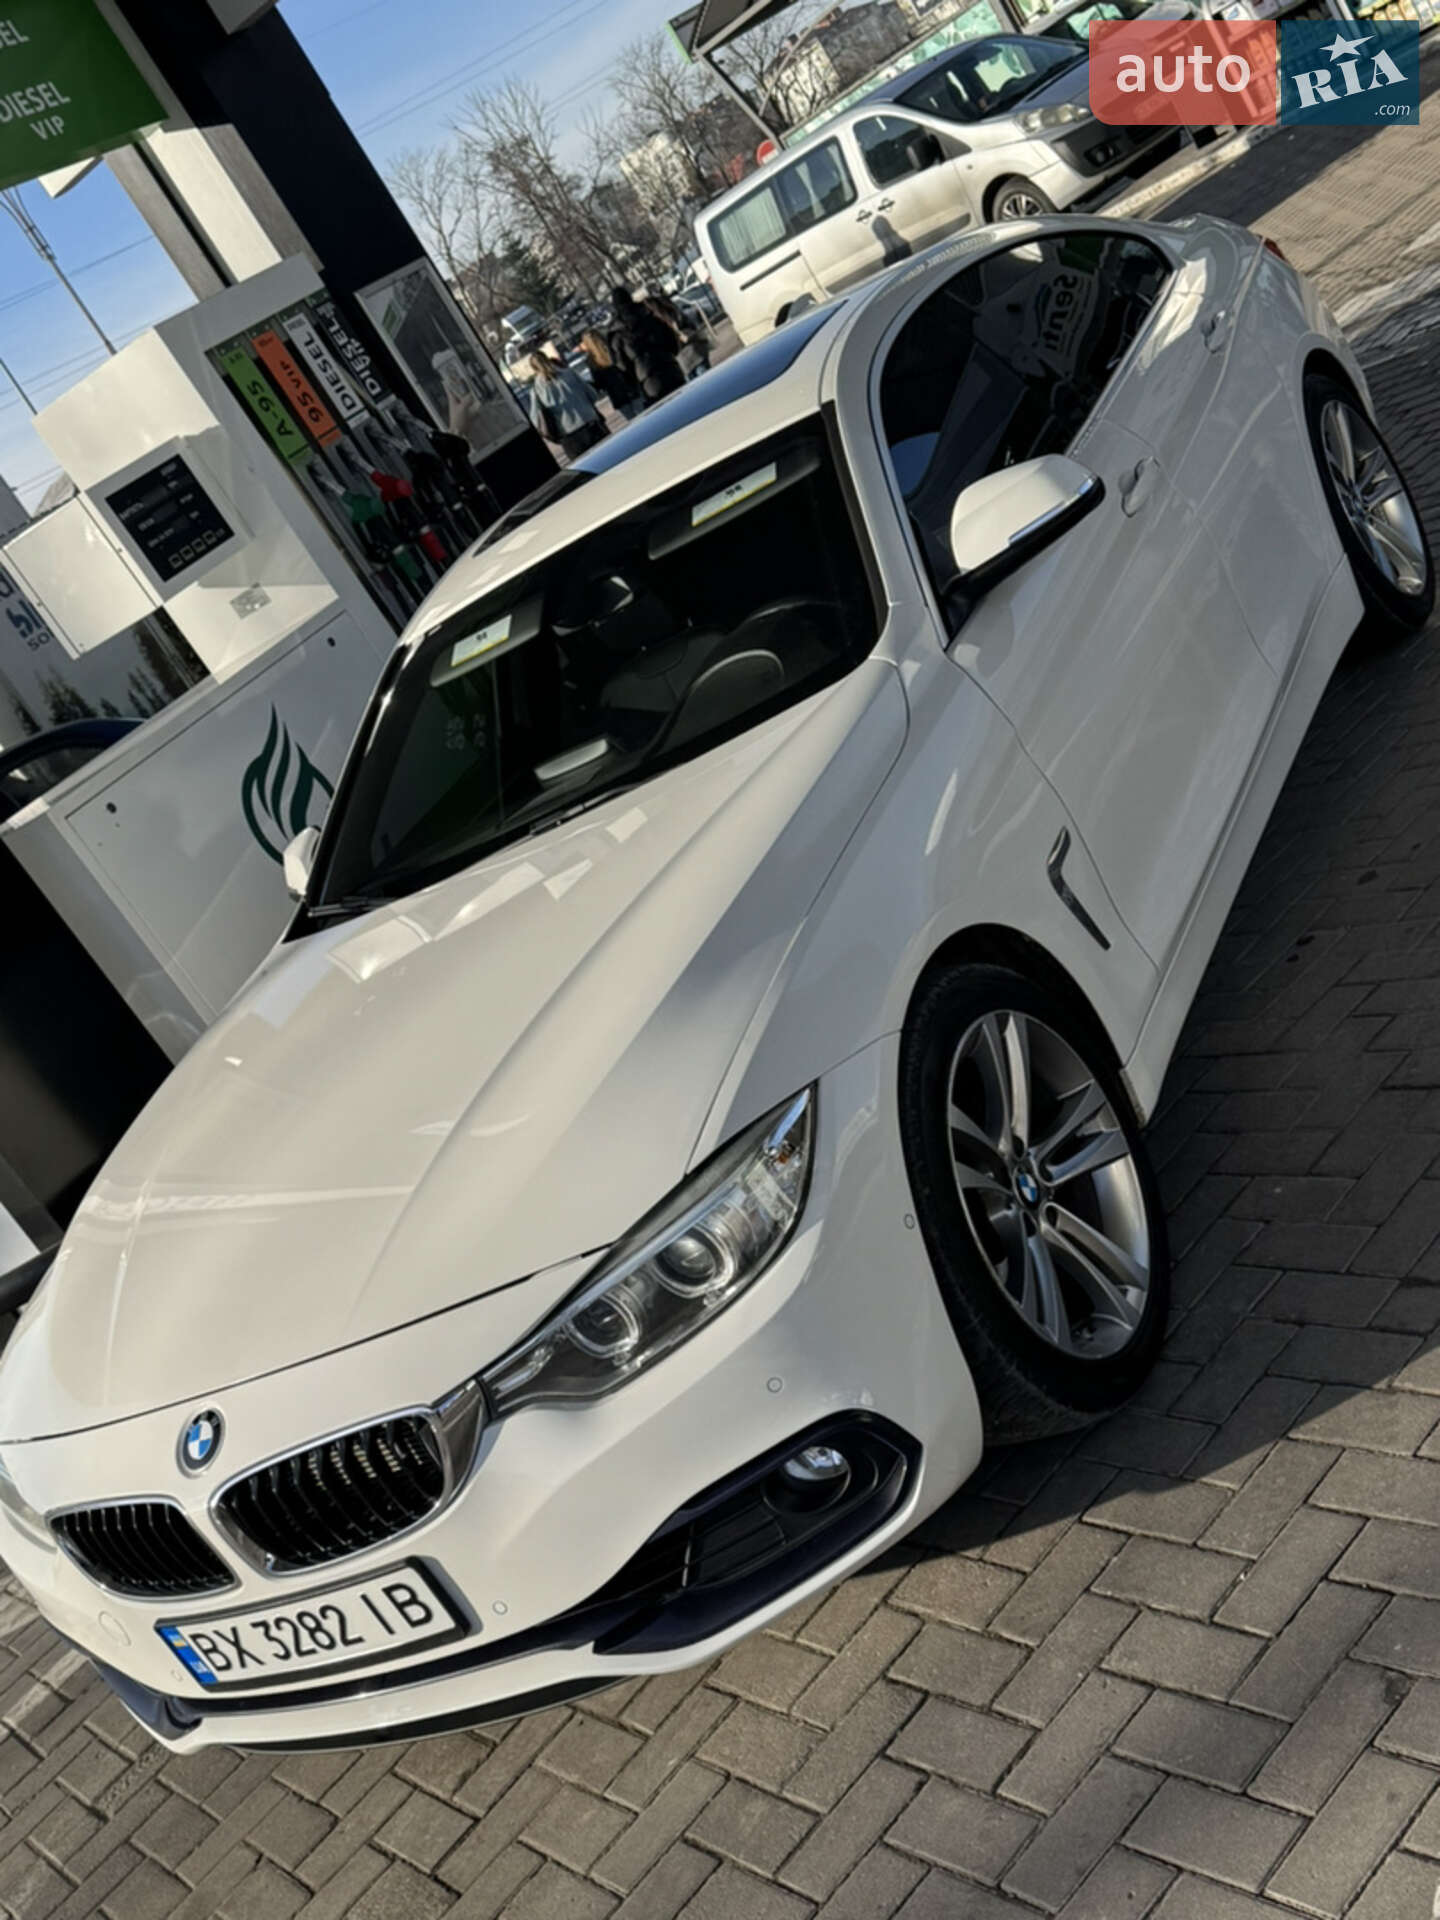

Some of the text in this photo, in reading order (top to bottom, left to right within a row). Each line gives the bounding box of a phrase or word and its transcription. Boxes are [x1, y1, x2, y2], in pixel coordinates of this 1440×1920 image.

[0, 19, 29, 48] EL
[0, 81, 71, 123] DIESEL
[29, 115, 65, 140] VIP
[279, 360, 302, 385] VIP
[303, 334, 355, 411] DIESEL
[328, 317, 382, 395] DIESEL
[247, 380, 296, 437] A-95
[296, 390, 324, 424] 95
[189, 1583, 434, 1672] BX 3282 IB
